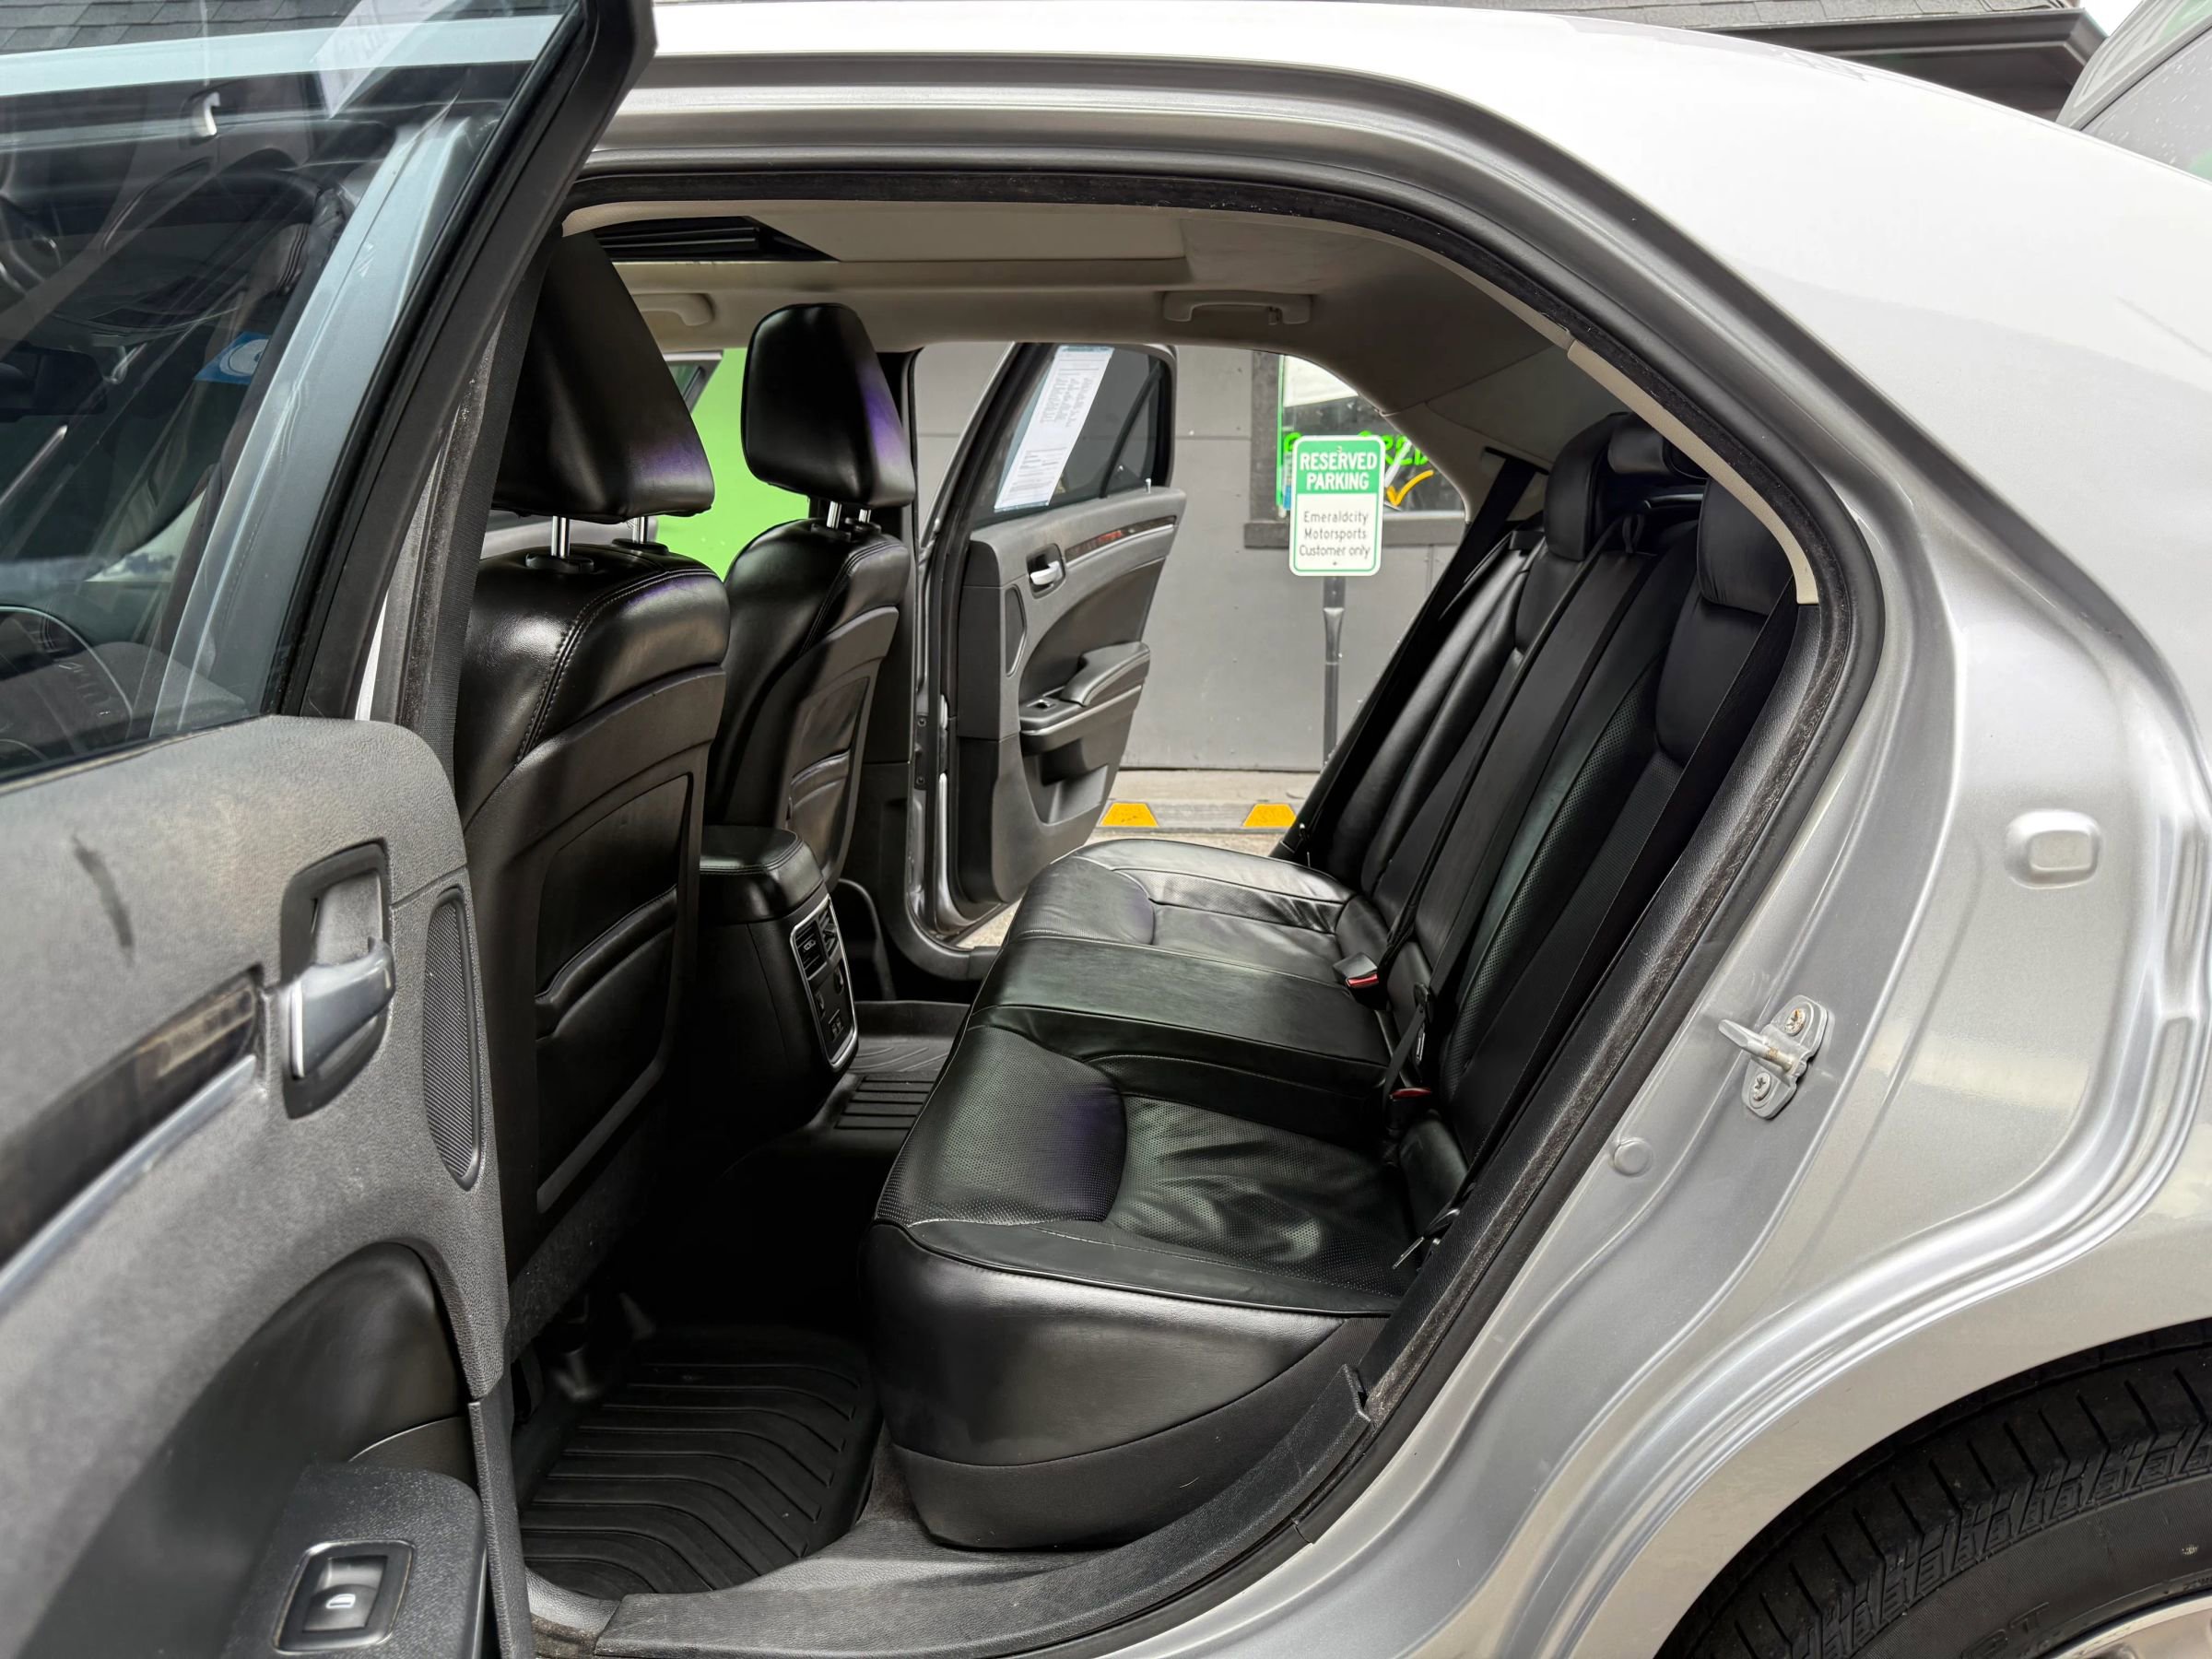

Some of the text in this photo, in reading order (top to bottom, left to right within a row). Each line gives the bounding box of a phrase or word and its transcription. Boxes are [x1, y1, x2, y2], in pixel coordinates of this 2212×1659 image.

[1300, 453, 1377, 470] RESERVED
[1306, 473, 1370, 490] PARKING
[1303, 511, 1369, 524] Emeraldcity
[1304, 528, 1367, 542] Motorsports
[1300, 545, 1371, 559] Customer only
